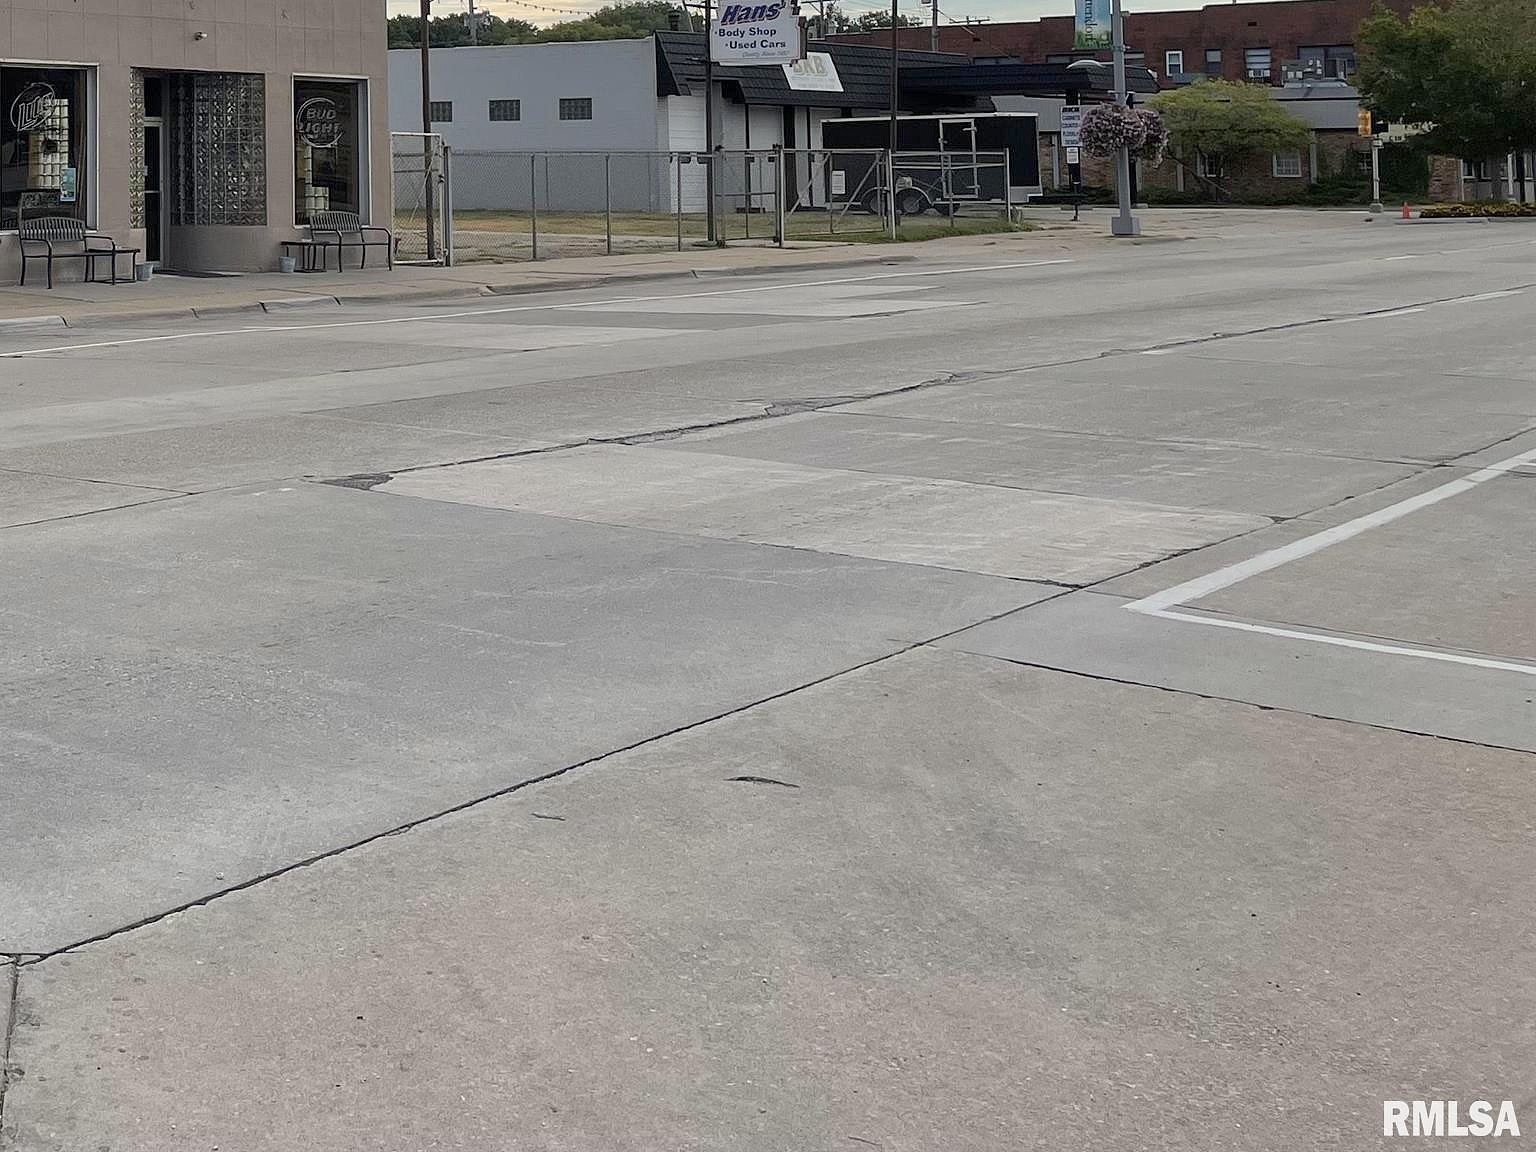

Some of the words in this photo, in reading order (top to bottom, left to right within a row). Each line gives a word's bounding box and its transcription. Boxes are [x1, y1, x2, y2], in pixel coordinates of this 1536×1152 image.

[719, 28, 745, 38] Body
[749, 27, 777, 37] Shop
[729, 40, 756, 49] Used
[760, 39, 786, 48] Cars
[306, 108, 336, 119] BUD
